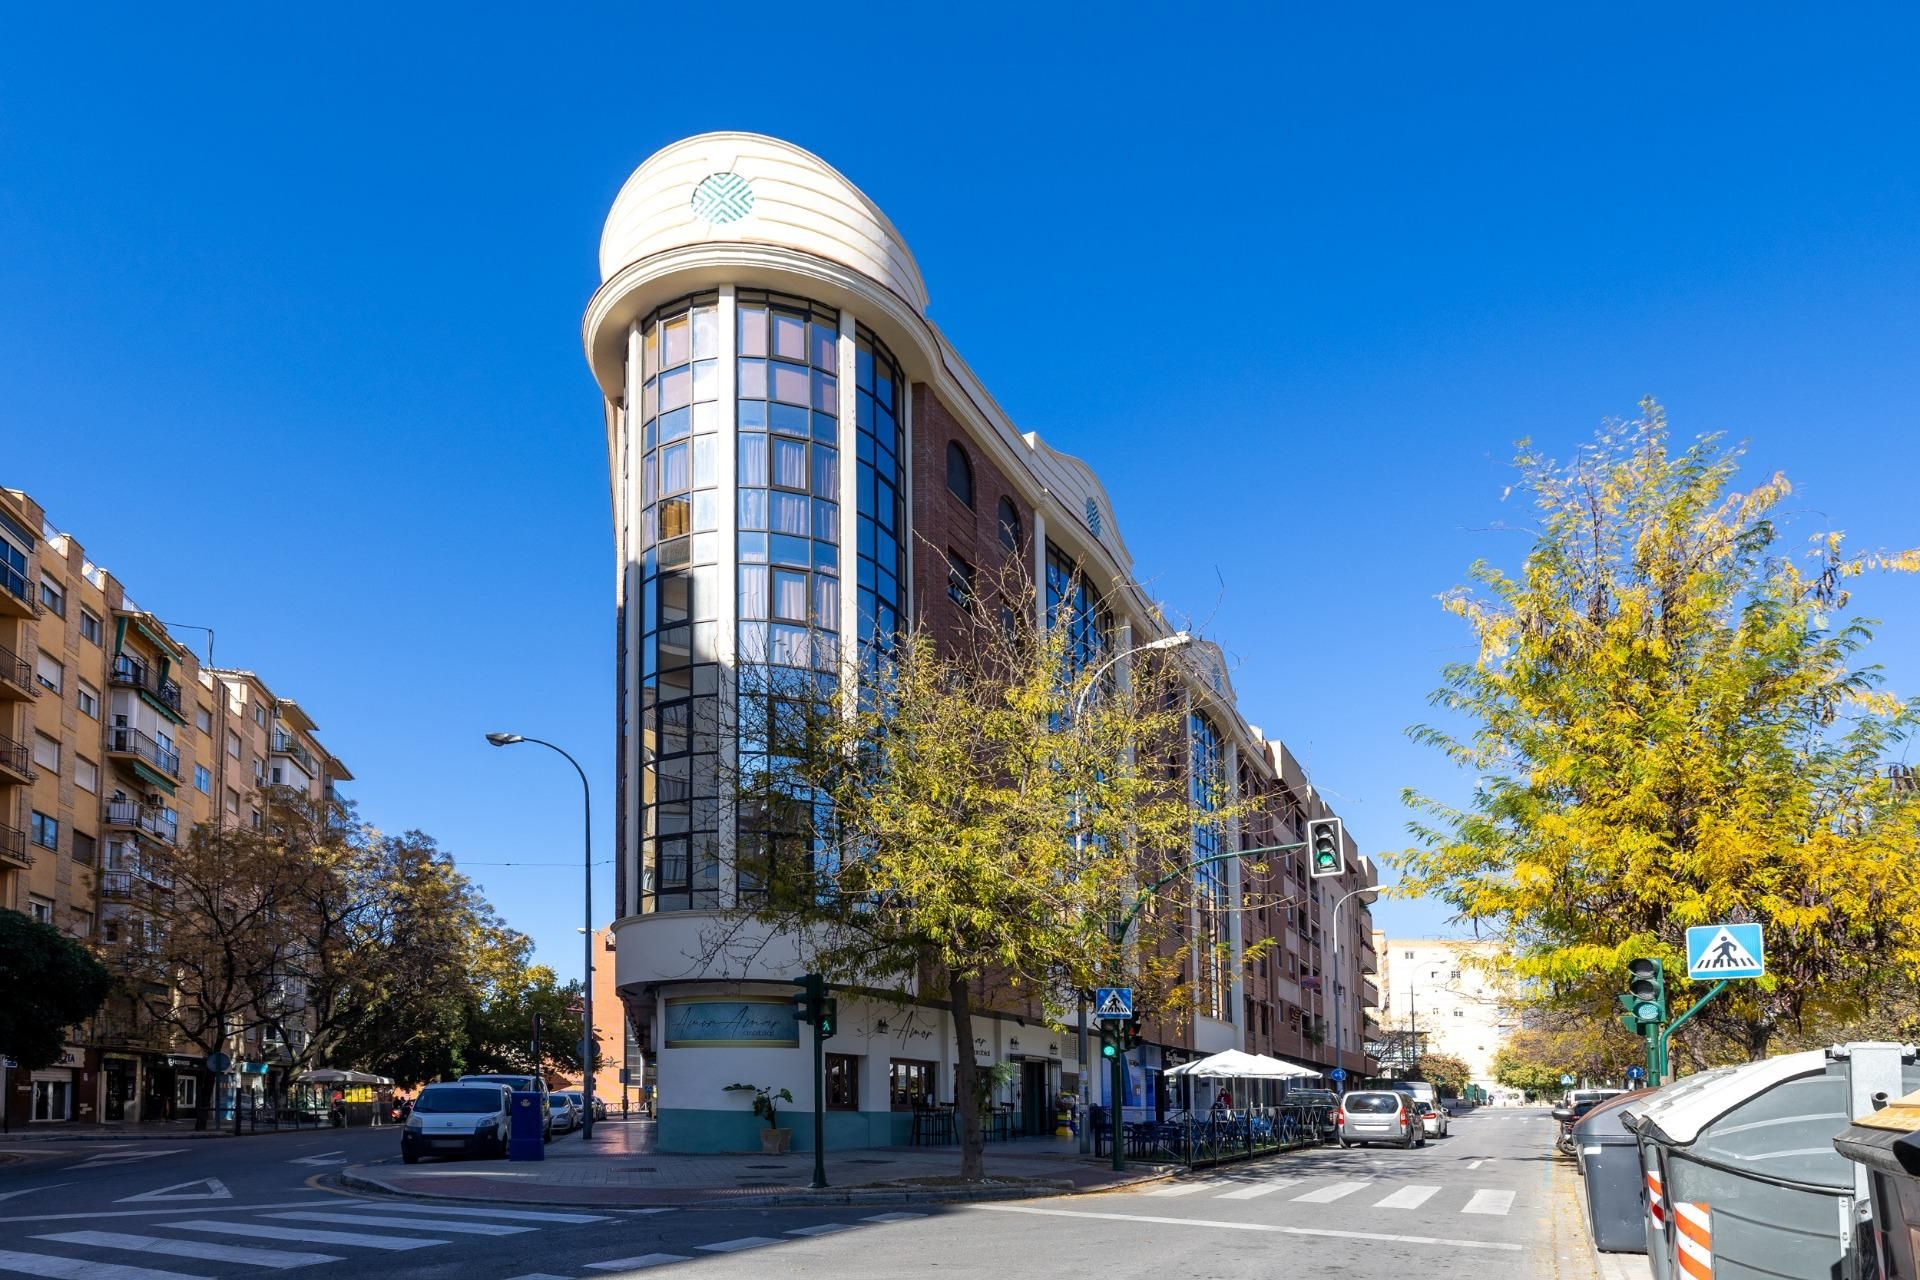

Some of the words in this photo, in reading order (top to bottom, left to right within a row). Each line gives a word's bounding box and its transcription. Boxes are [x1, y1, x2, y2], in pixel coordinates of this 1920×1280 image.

[672, 1006, 717, 1038] Amor
[719, 1005, 781, 1038] Amor
[893, 1010, 934, 1050] Amor
